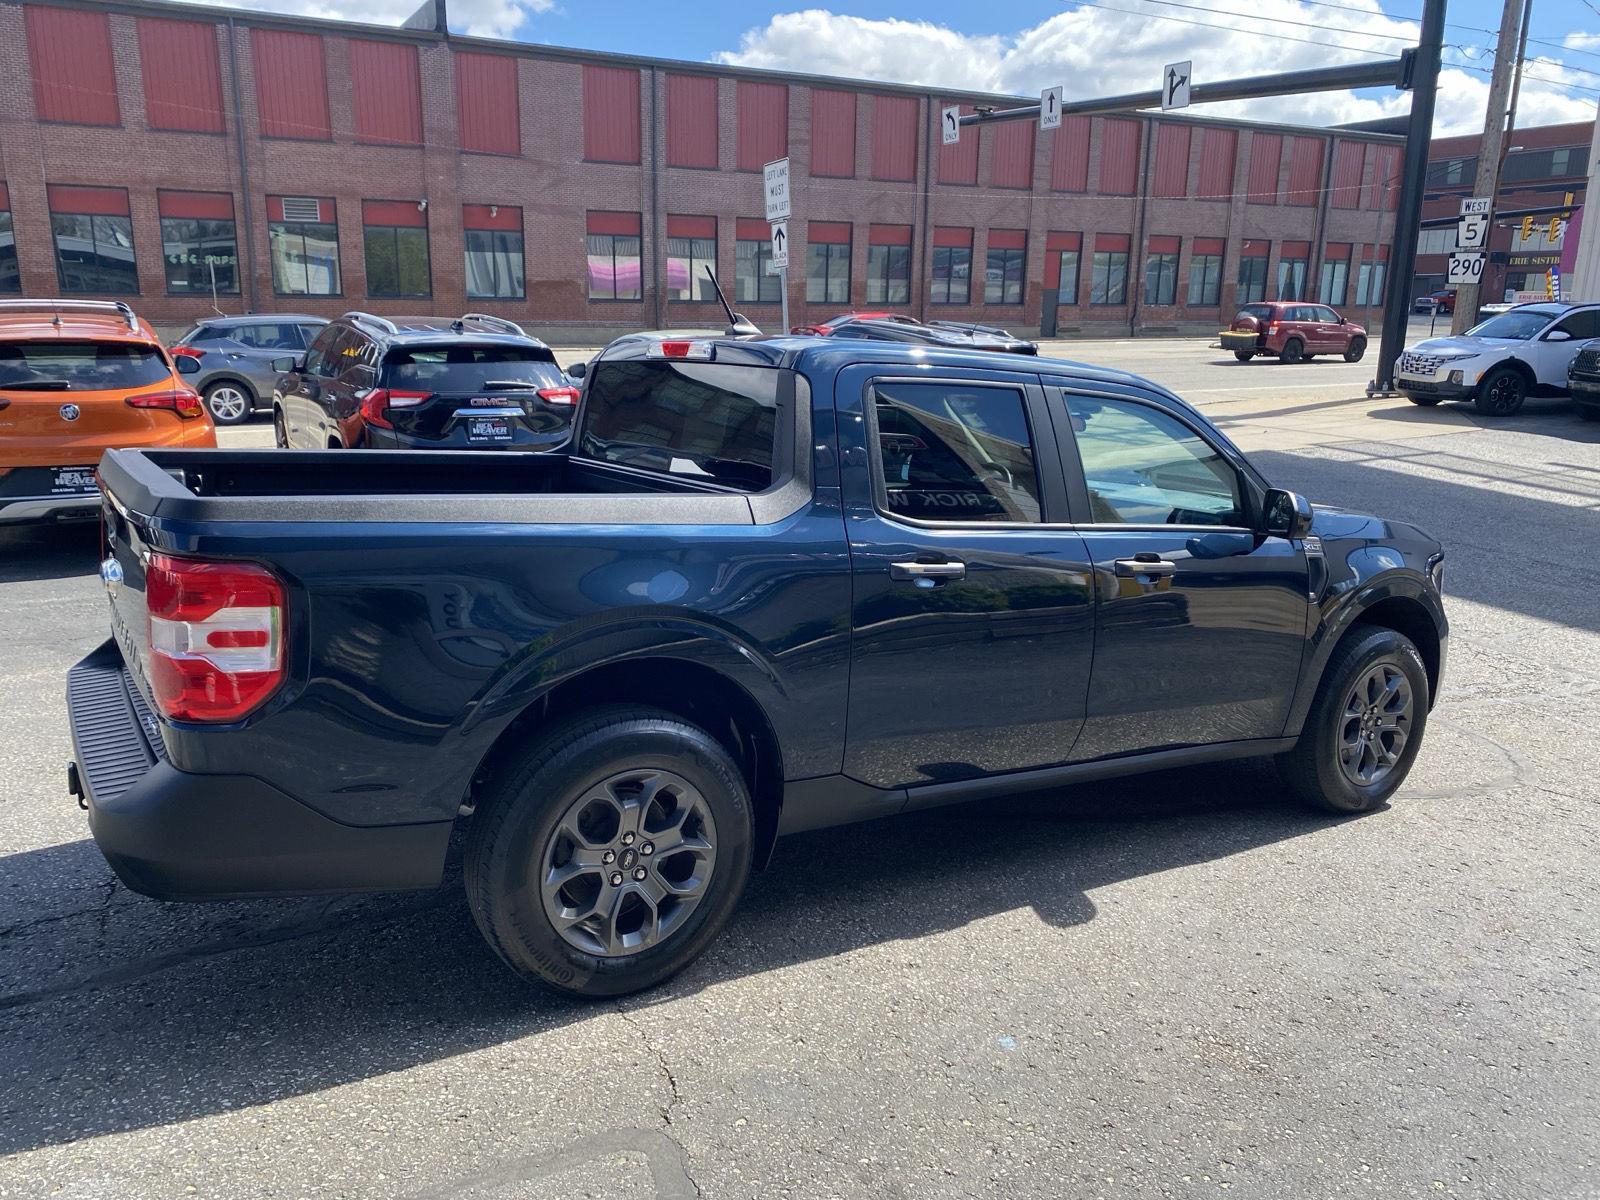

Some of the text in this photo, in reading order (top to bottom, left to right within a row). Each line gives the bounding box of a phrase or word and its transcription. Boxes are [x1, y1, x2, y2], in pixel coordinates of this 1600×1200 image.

[1043, 116, 1058, 124] ONLY
[945, 132, 957, 141] ONLY
[766, 167, 788, 182] LEFT LANE
[770, 184, 784, 197] MUST
[767, 200, 789, 214] TURN LEFT
[1464, 201, 1488, 212] WEST
[1465, 223, 1478, 241] 5
[1450, 259, 1482, 276] 290
[470, 398, 508, 407] GMC
